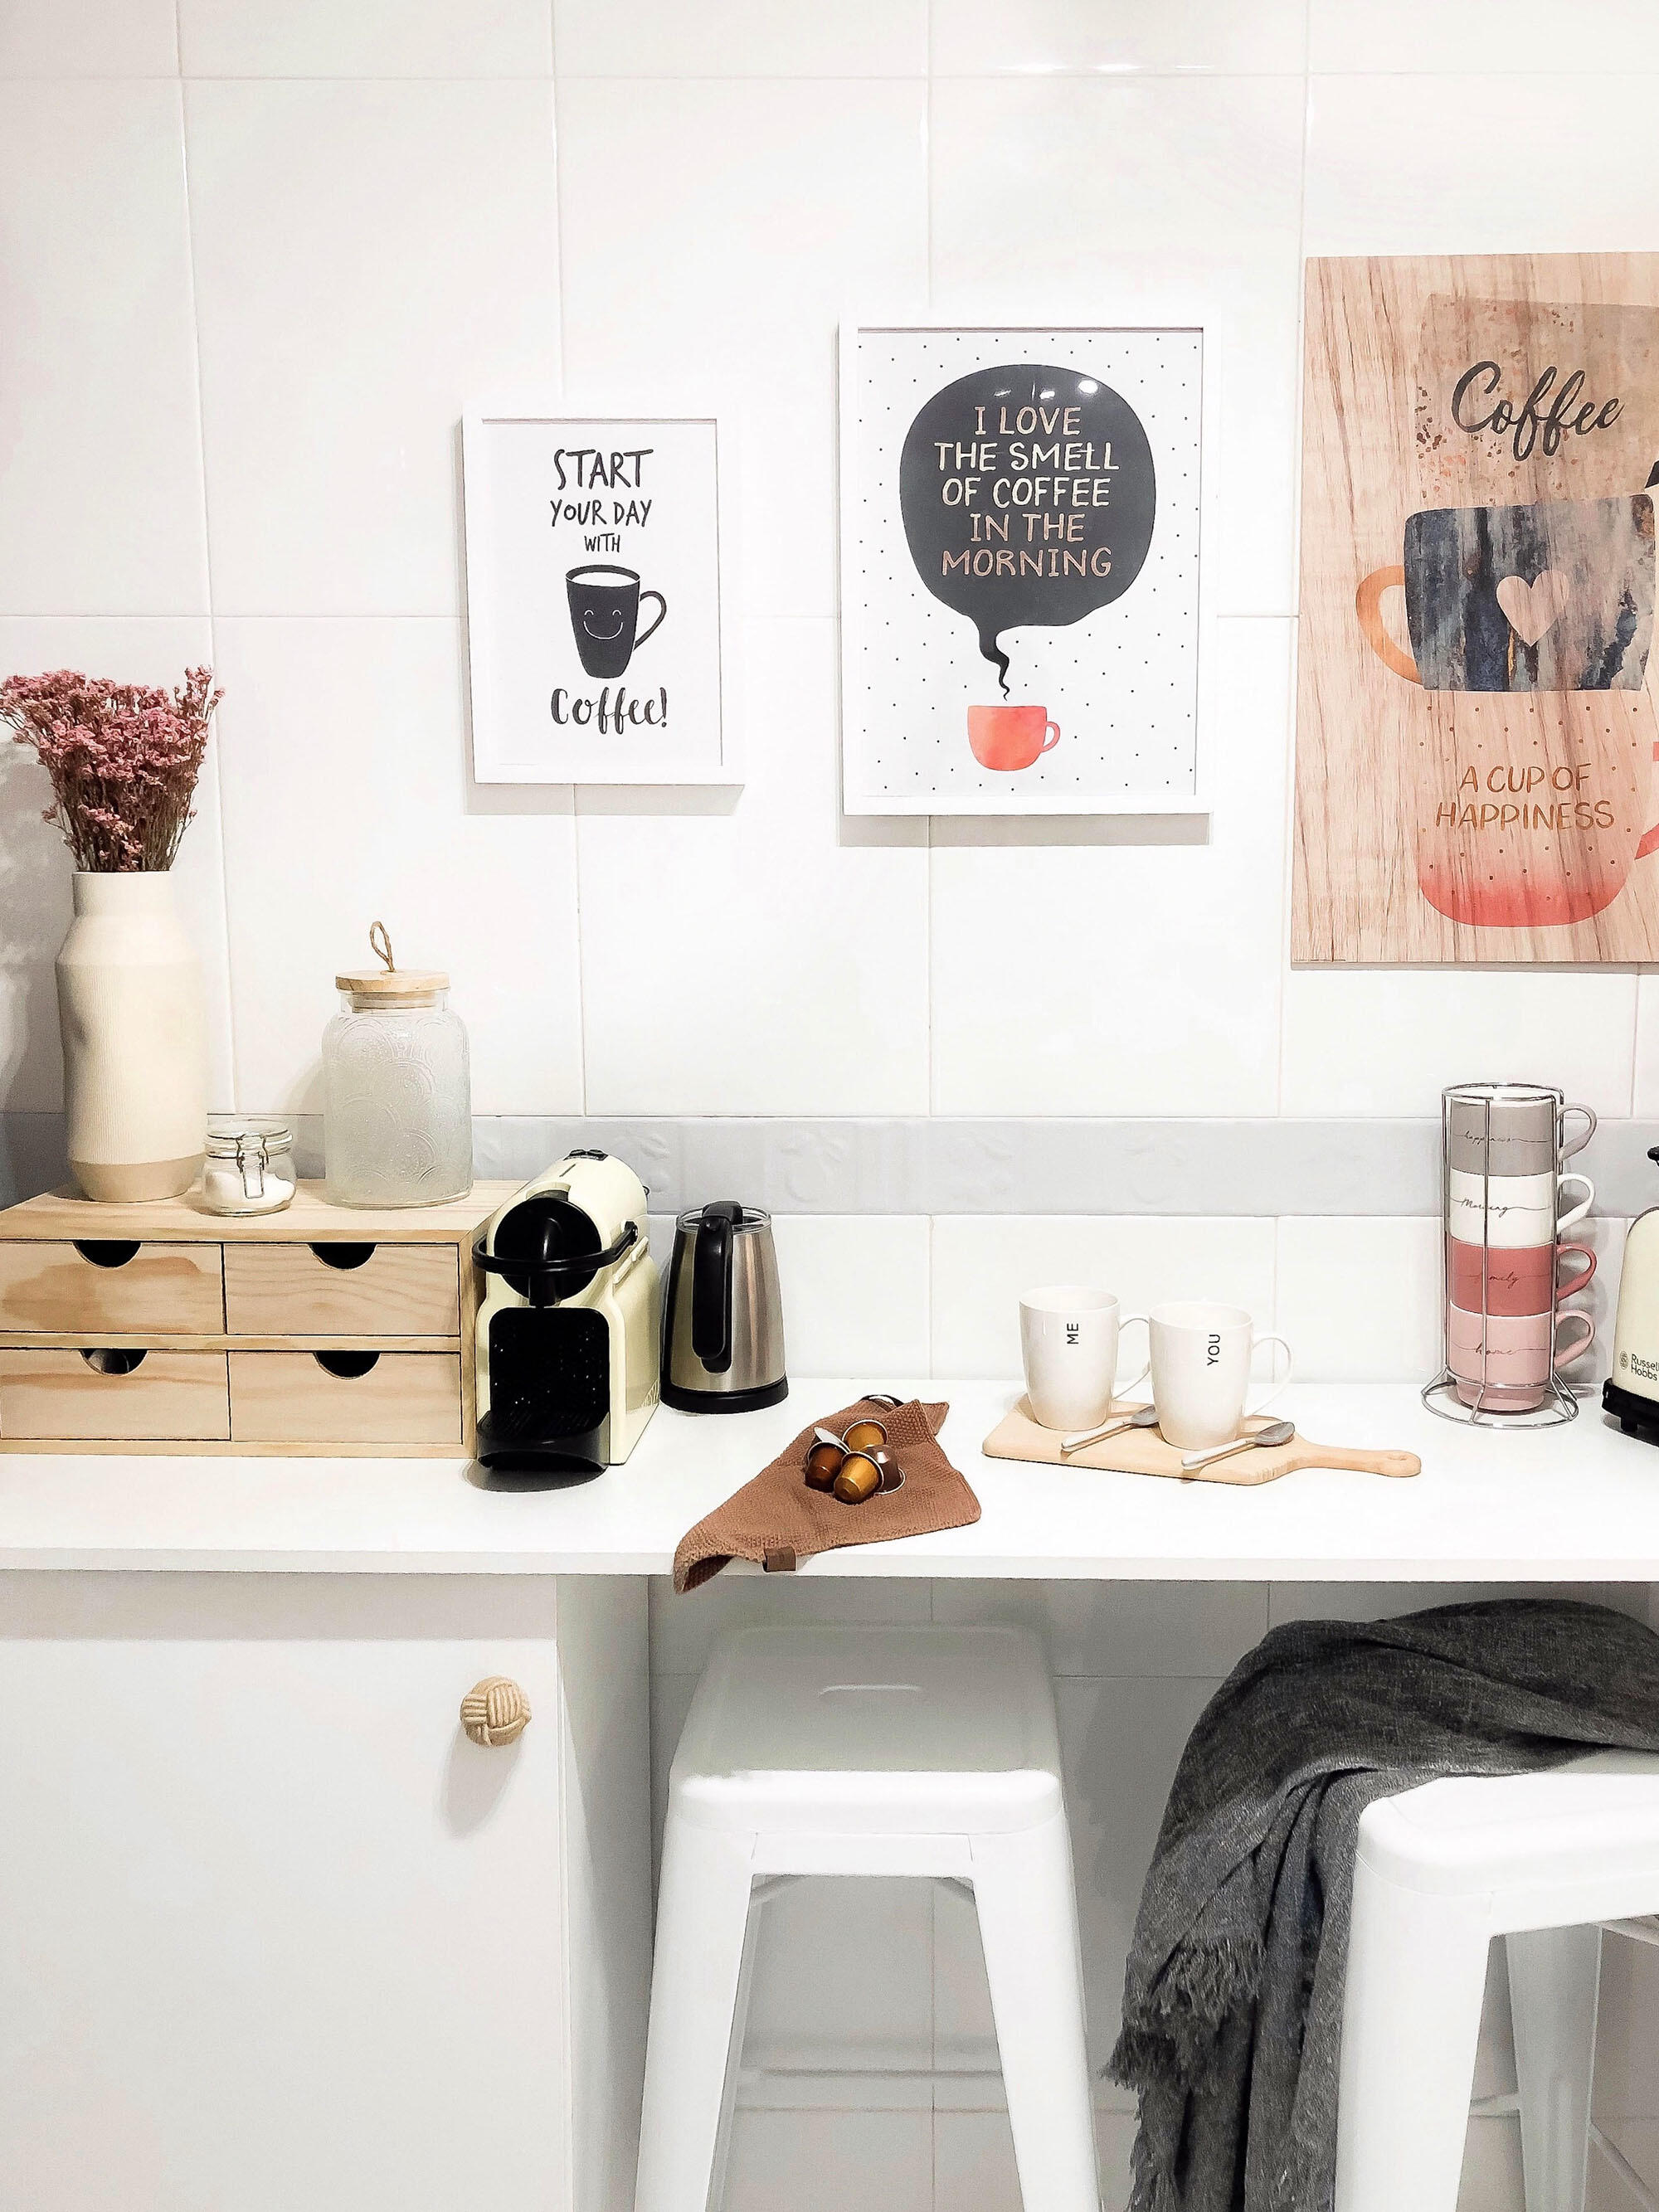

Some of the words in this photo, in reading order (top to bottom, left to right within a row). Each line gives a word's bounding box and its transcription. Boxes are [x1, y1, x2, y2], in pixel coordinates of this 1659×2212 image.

[974, 406, 987, 435] I
[999, 406, 1082, 436] LOVE
[1451, 360, 1625, 461] Coffee
[553, 449, 654, 491] START
[934, 441, 998, 472] THE
[1009, 441, 1120, 472] SMELL
[941, 477, 981, 507] OF
[992, 477, 1112, 508] COFFEE
[550, 498, 607, 527] YOUR
[613, 498, 653, 527] DAY
[584, 532, 620, 553] WITH
[970, 513, 1010, 543] IN
[1022, 513, 1086, 542] THE
[941, 548, 1112, 577] MORNING
[550, 686, 668, 735] Coffee!
[1459, 766, 1479, 793] A
[1486, 766, 1545, 793] CUP
[1552, 763, 1593, 791] OF
[1435, 800, 1615, 831] HAPPINESS
[1066, 1323, 1079, 1345] ME
[1207, 1334, 1221, 1366] YOU
[1631, 1364, 1657, 1381] Hobbs
